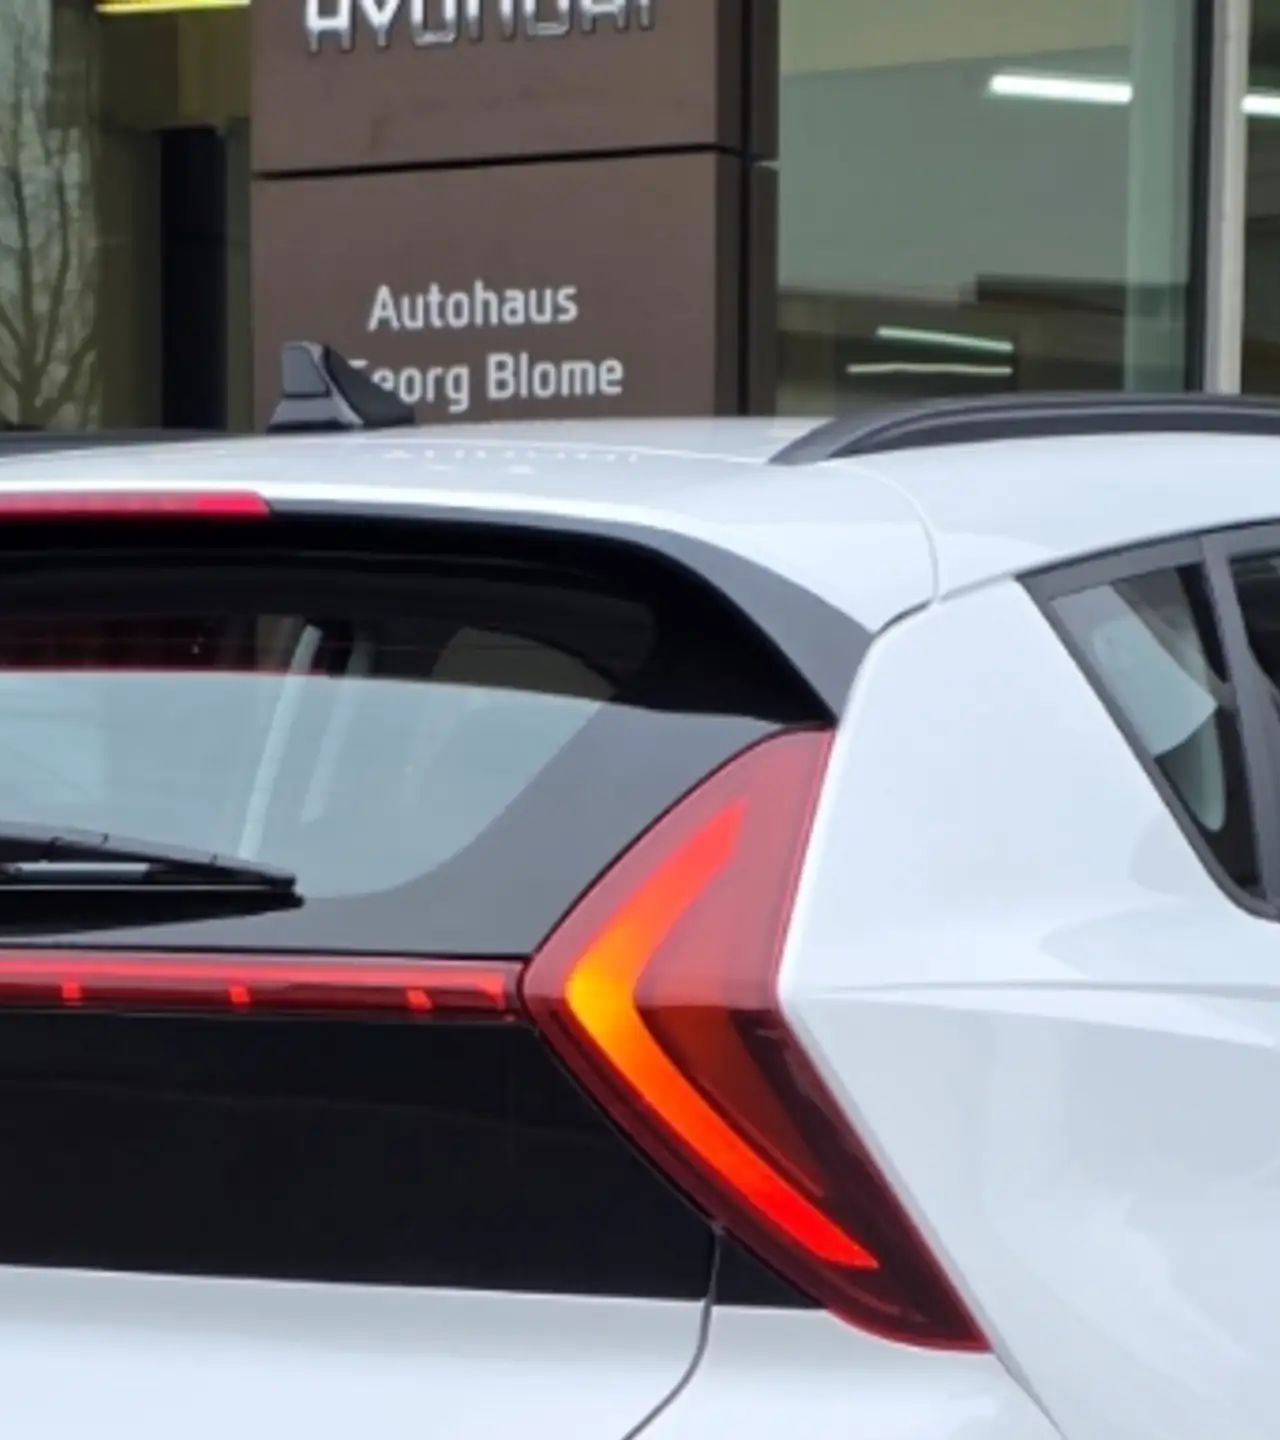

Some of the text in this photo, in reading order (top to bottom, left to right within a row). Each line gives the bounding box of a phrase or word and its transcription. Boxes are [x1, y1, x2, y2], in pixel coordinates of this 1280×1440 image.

[367, 278, 578, 332] Autohaus
[348, 351, 624, 414] eorg Blome
